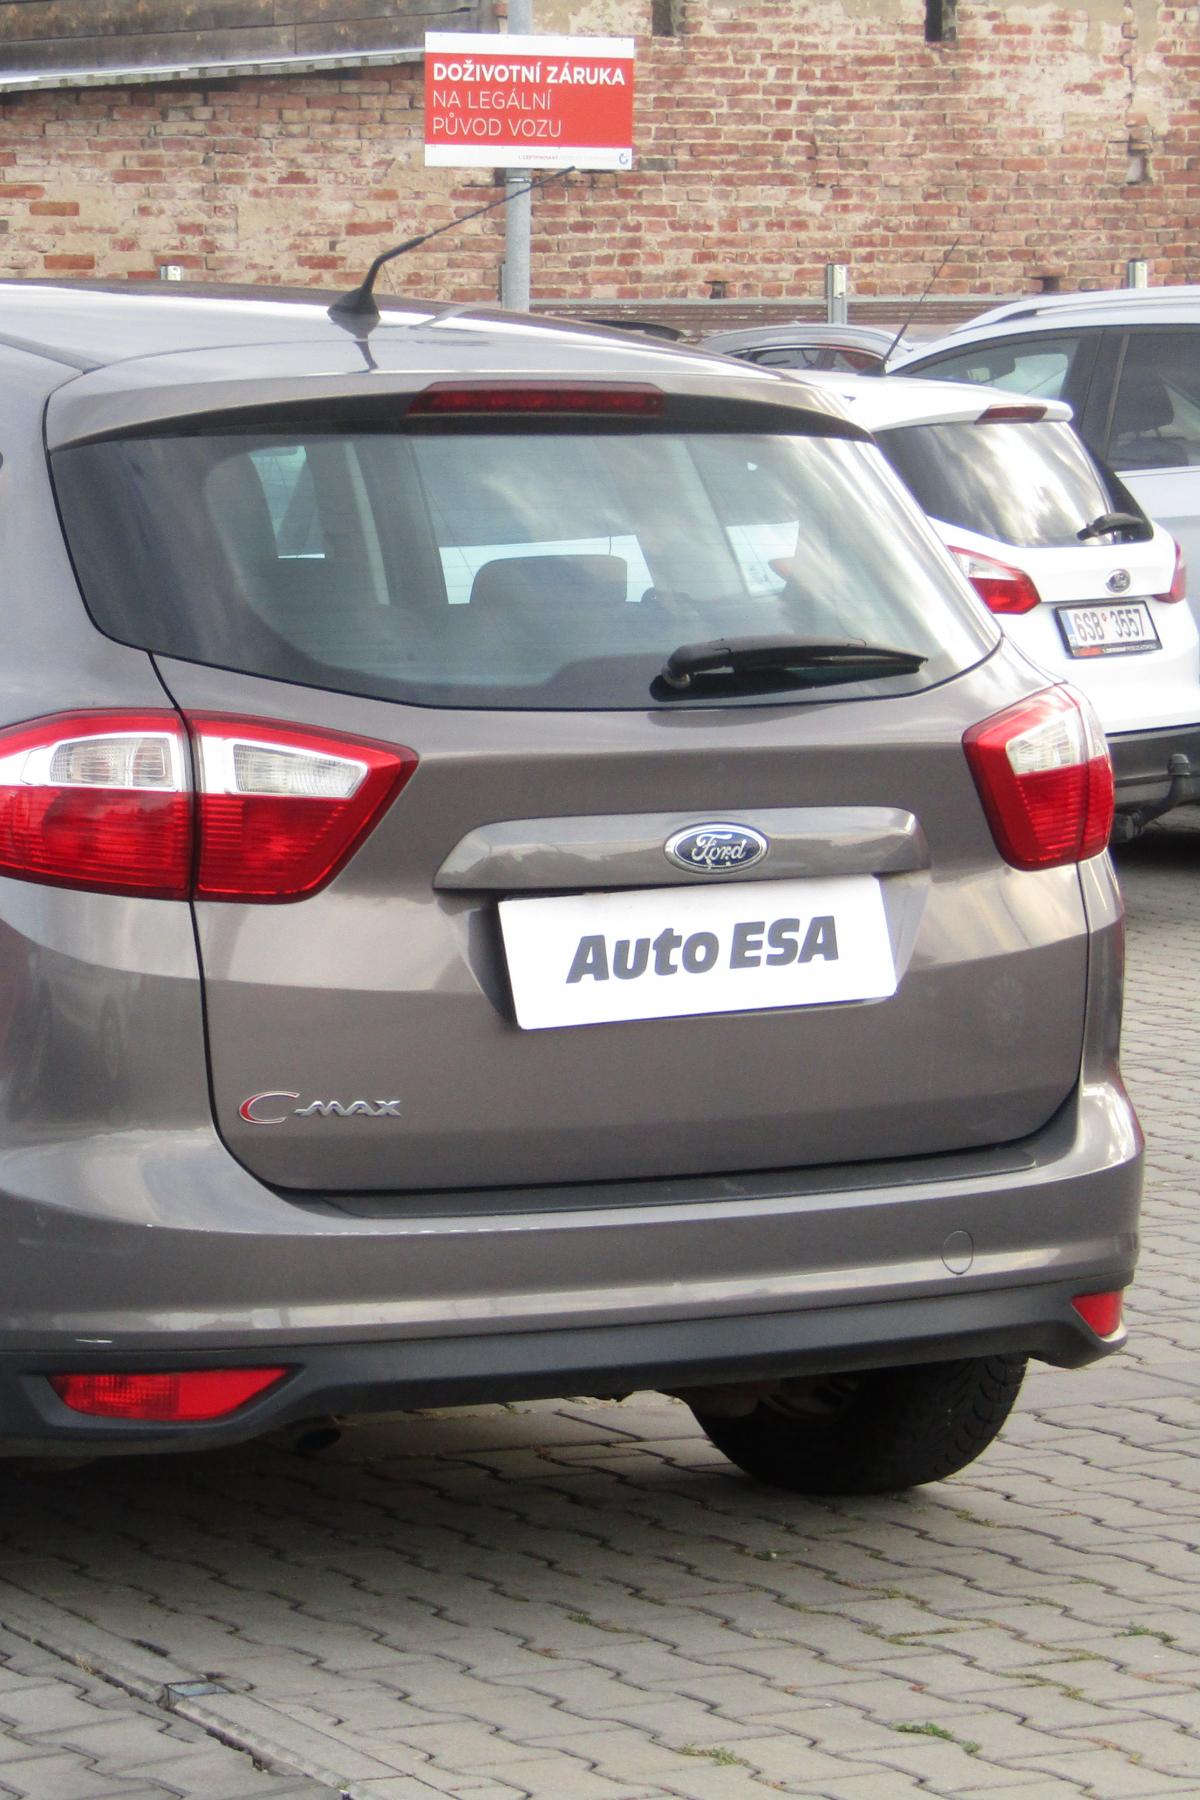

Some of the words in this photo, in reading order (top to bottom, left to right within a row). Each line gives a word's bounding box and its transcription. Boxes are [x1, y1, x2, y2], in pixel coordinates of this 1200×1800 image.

[433, 59, 541, 83] DOŽIVOTNÍ
[546, 62, 625, 86] ZÁRUKA
[433, 89, 462, 108] NA
[468, 88, 552, 110] LEGÁLNÍ
[433, 112, 502, 136] PŮVOD
[508, 118, 562, 137] VOZU
[1073, 611, 1105, 642] 6SB
[1109, 608, 1145, 638] 3557
[691, 833, 748, 861] Ford
[565, 928, 719, 984] Auto
[729, 915, 839, 970] ESA
